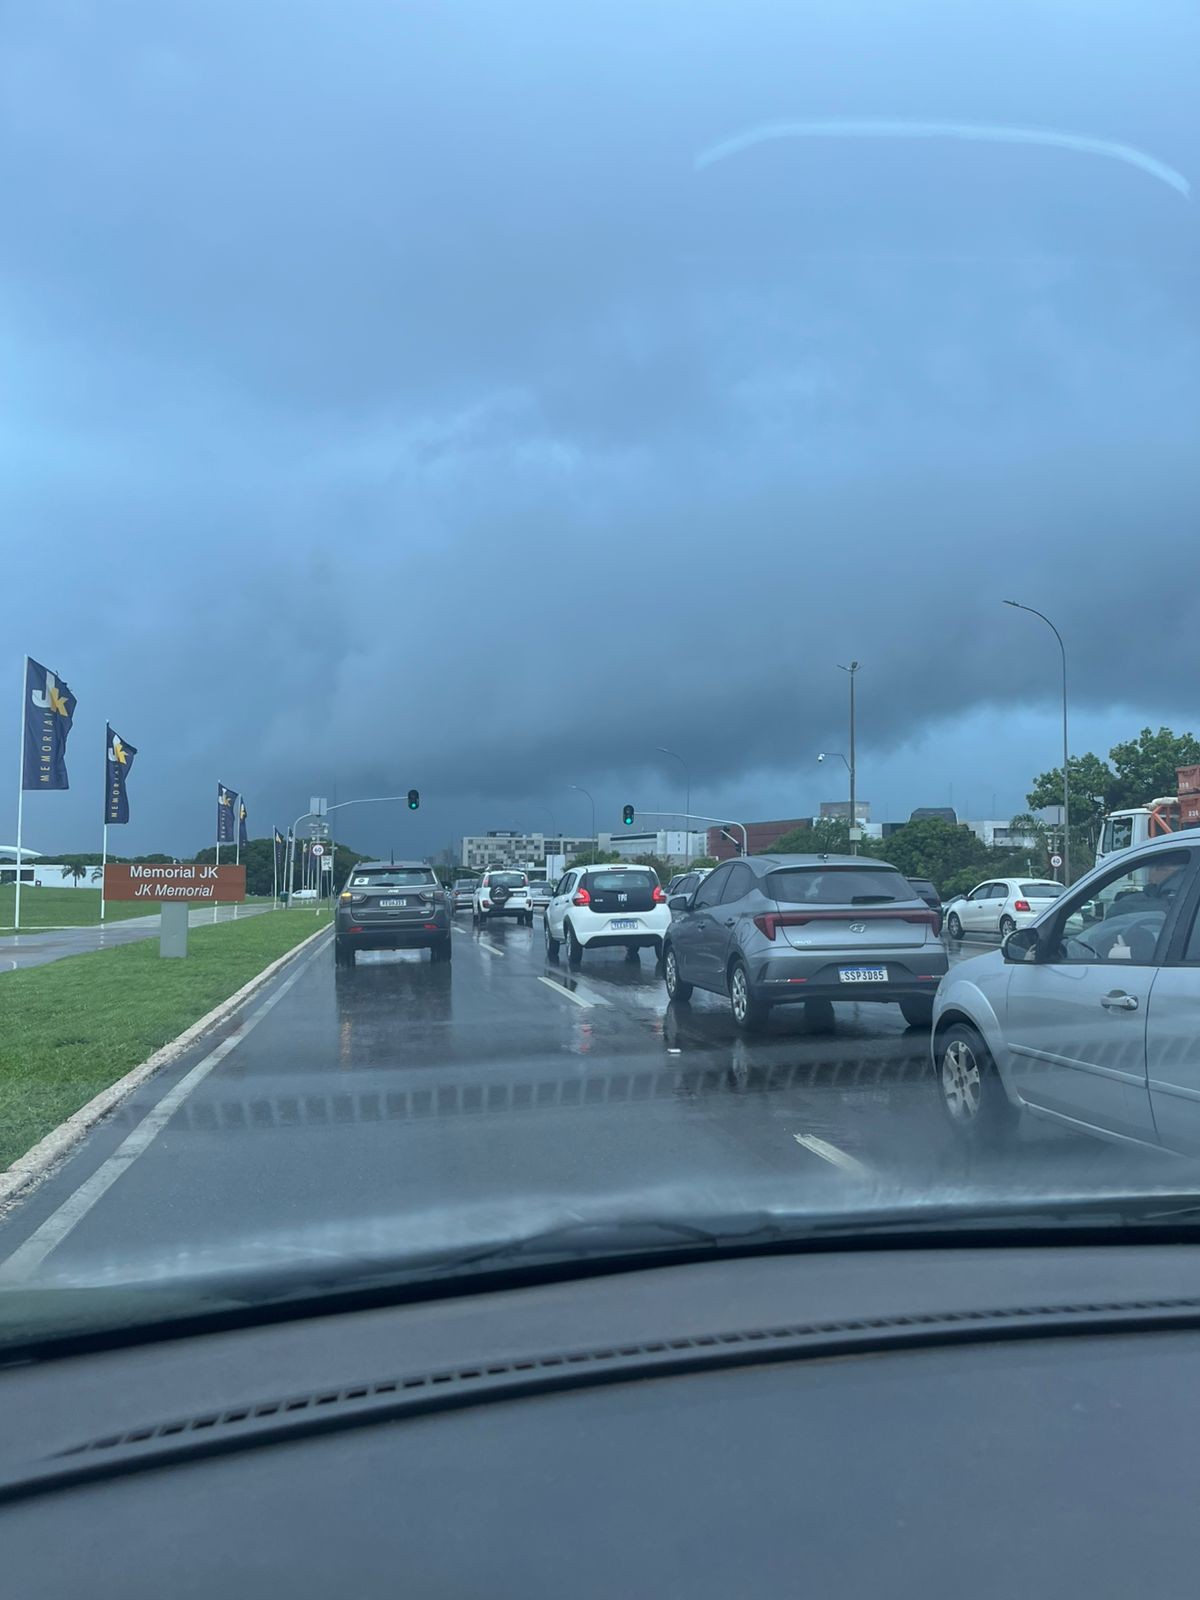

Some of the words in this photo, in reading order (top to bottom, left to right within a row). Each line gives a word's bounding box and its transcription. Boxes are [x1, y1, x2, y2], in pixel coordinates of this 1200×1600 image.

[130, 866, 195, 878] Memorial
[200, 866, 219, 879] JK
[134, 884, 152, 896] JK
[154, 884, 214, 896] Memorial
[844, 970, 884, 981] SSP3D85
